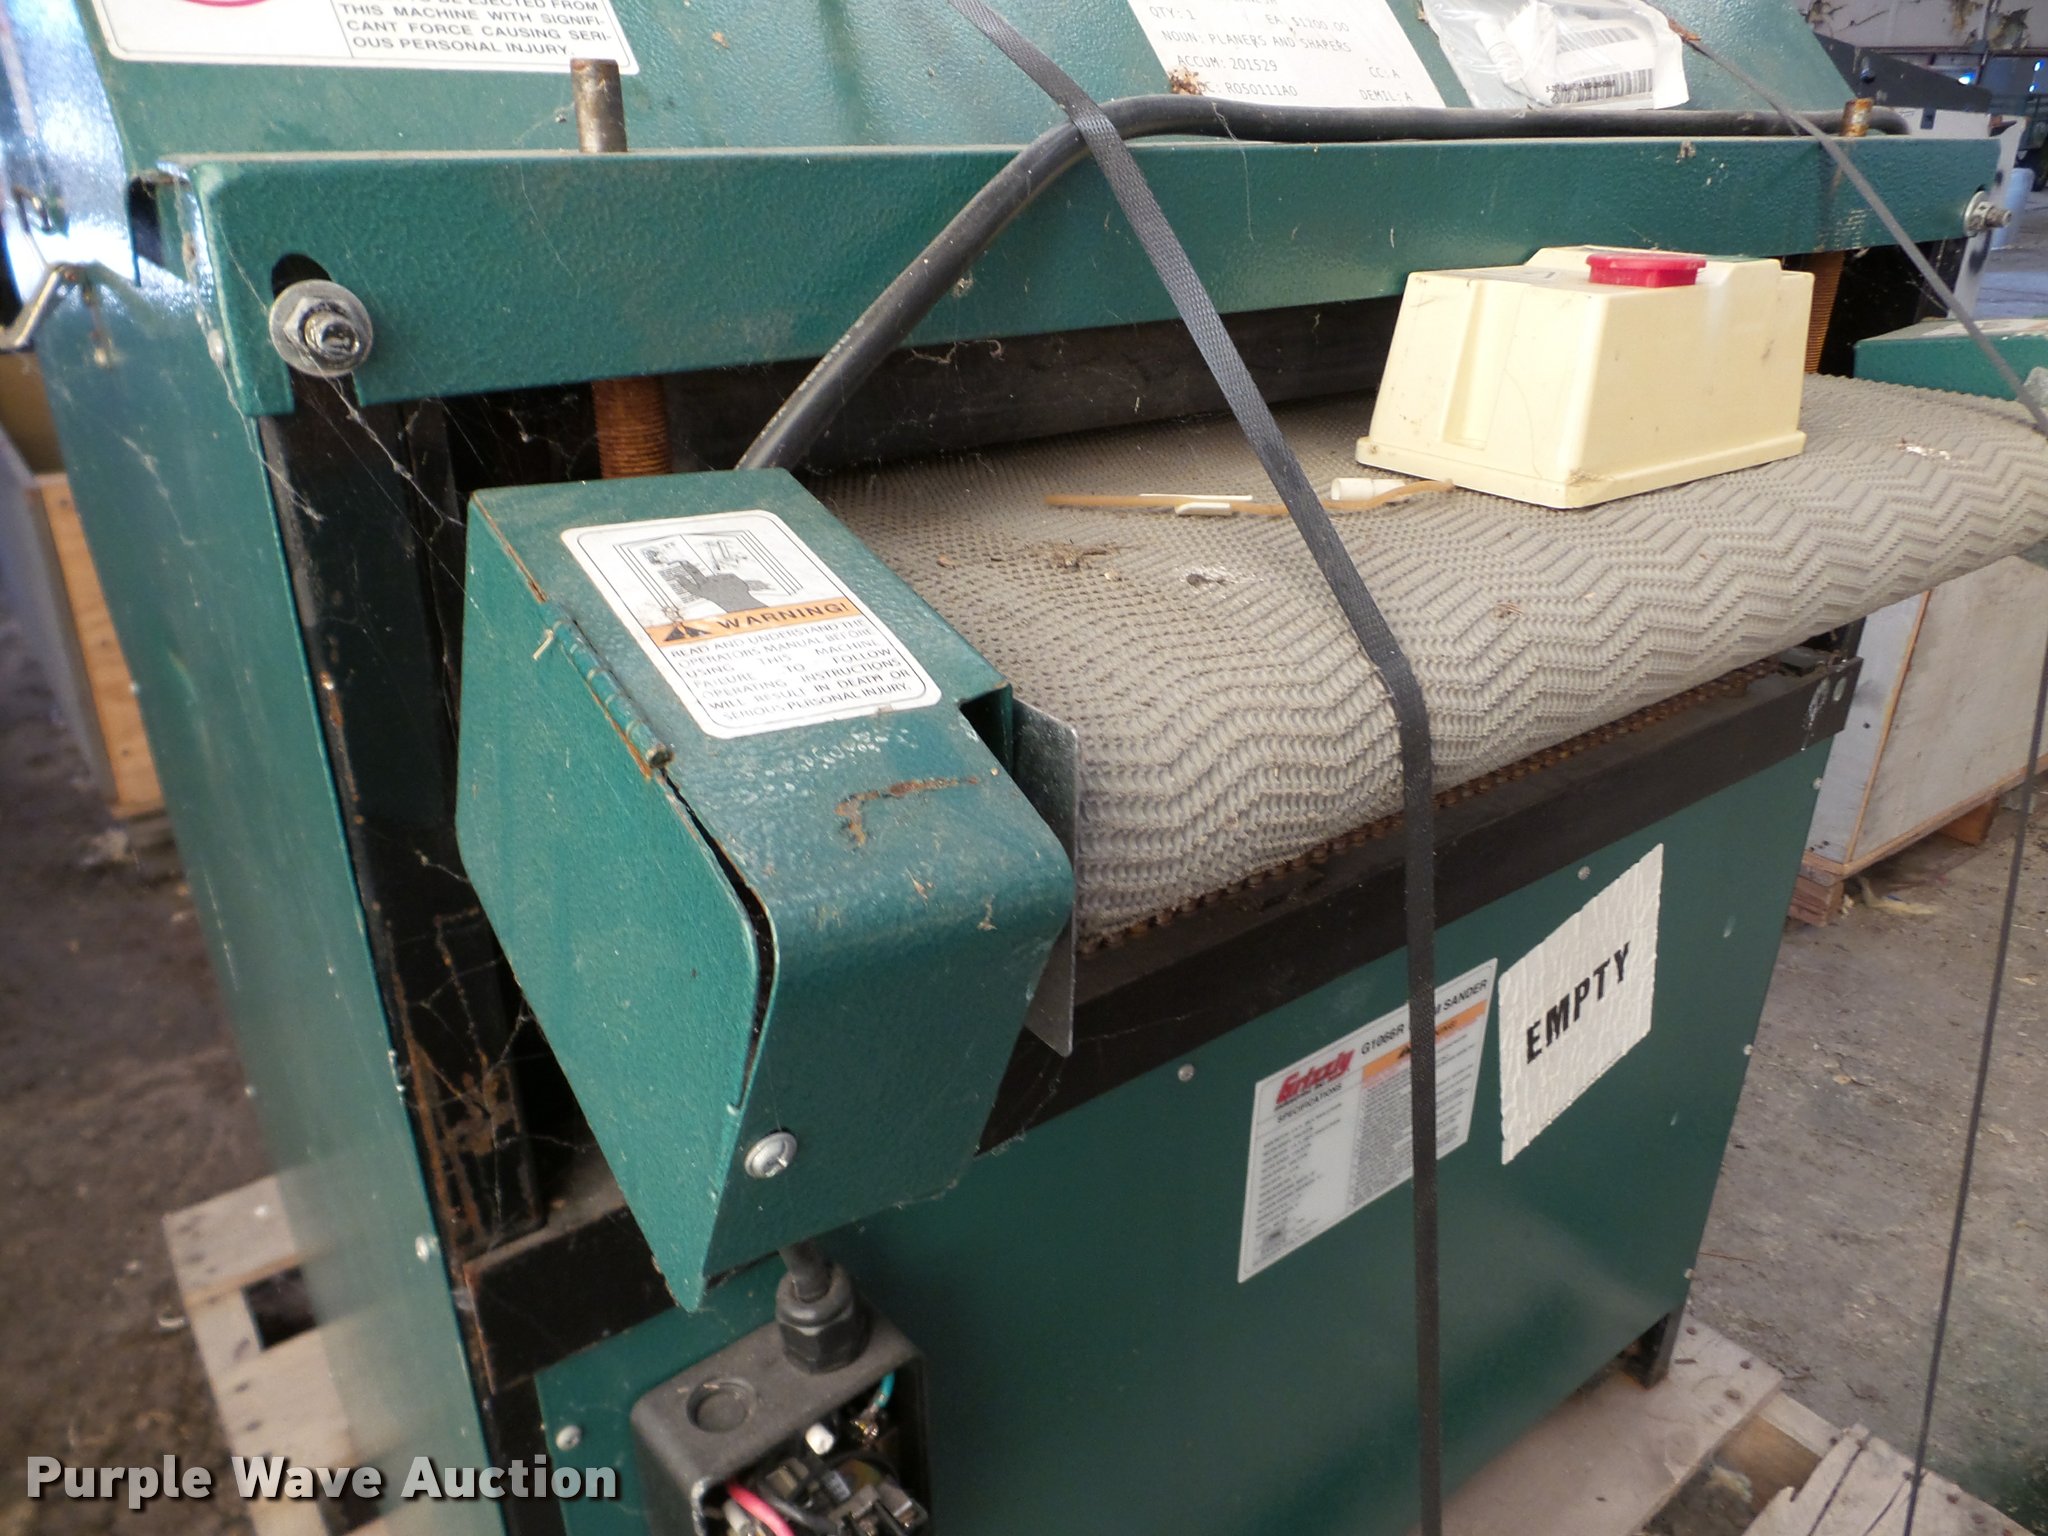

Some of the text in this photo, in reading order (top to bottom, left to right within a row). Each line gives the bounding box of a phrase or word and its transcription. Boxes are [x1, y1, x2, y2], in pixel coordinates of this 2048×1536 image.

[340, 4, 605, 25] THIS MACHINE WITH SIGNIFI-
[552, 0, 599, 11] FROM
[1149, 6, 1183, 18] QTY:
[346, 20, 612, 40] CANT FORCE CAUSING SERI-
[1161, 30, 1352, 52] NOUN: PLANERS AND SHAPERS
[353, 36, 575, 55] OUS PERSONAL INJURY.
[1177, 55, 1278, 71] ACCUM: 201529
[717, 602, 849, 629] WARNING!
[671, 619, 866, 657] READ AND UNDERSTAND THE
[679, 648, 760, 668] OPERATORS
[763, 637, 823, 653] MANUAL
[786, 663, 805, 673] TO
[832, 648, 891, 664] FOLLOW
[686, 664, 735, 678] USING
[759, 654, 792, 665] THIS
[702, 658, 901, 699] OPERATING INSTRUCTIONS
[709, 698, 744, 710] WILL
[813, 683, 830, 693] IN
[837, 674, 884, 689] DEATH
[890, 669, 911, 680] OR
[787, 691, 861, 710] PERSONAL
[1443, 979, 1488, 1011] SANDER
[1525, 941, 1631, 1065] EMPTY
